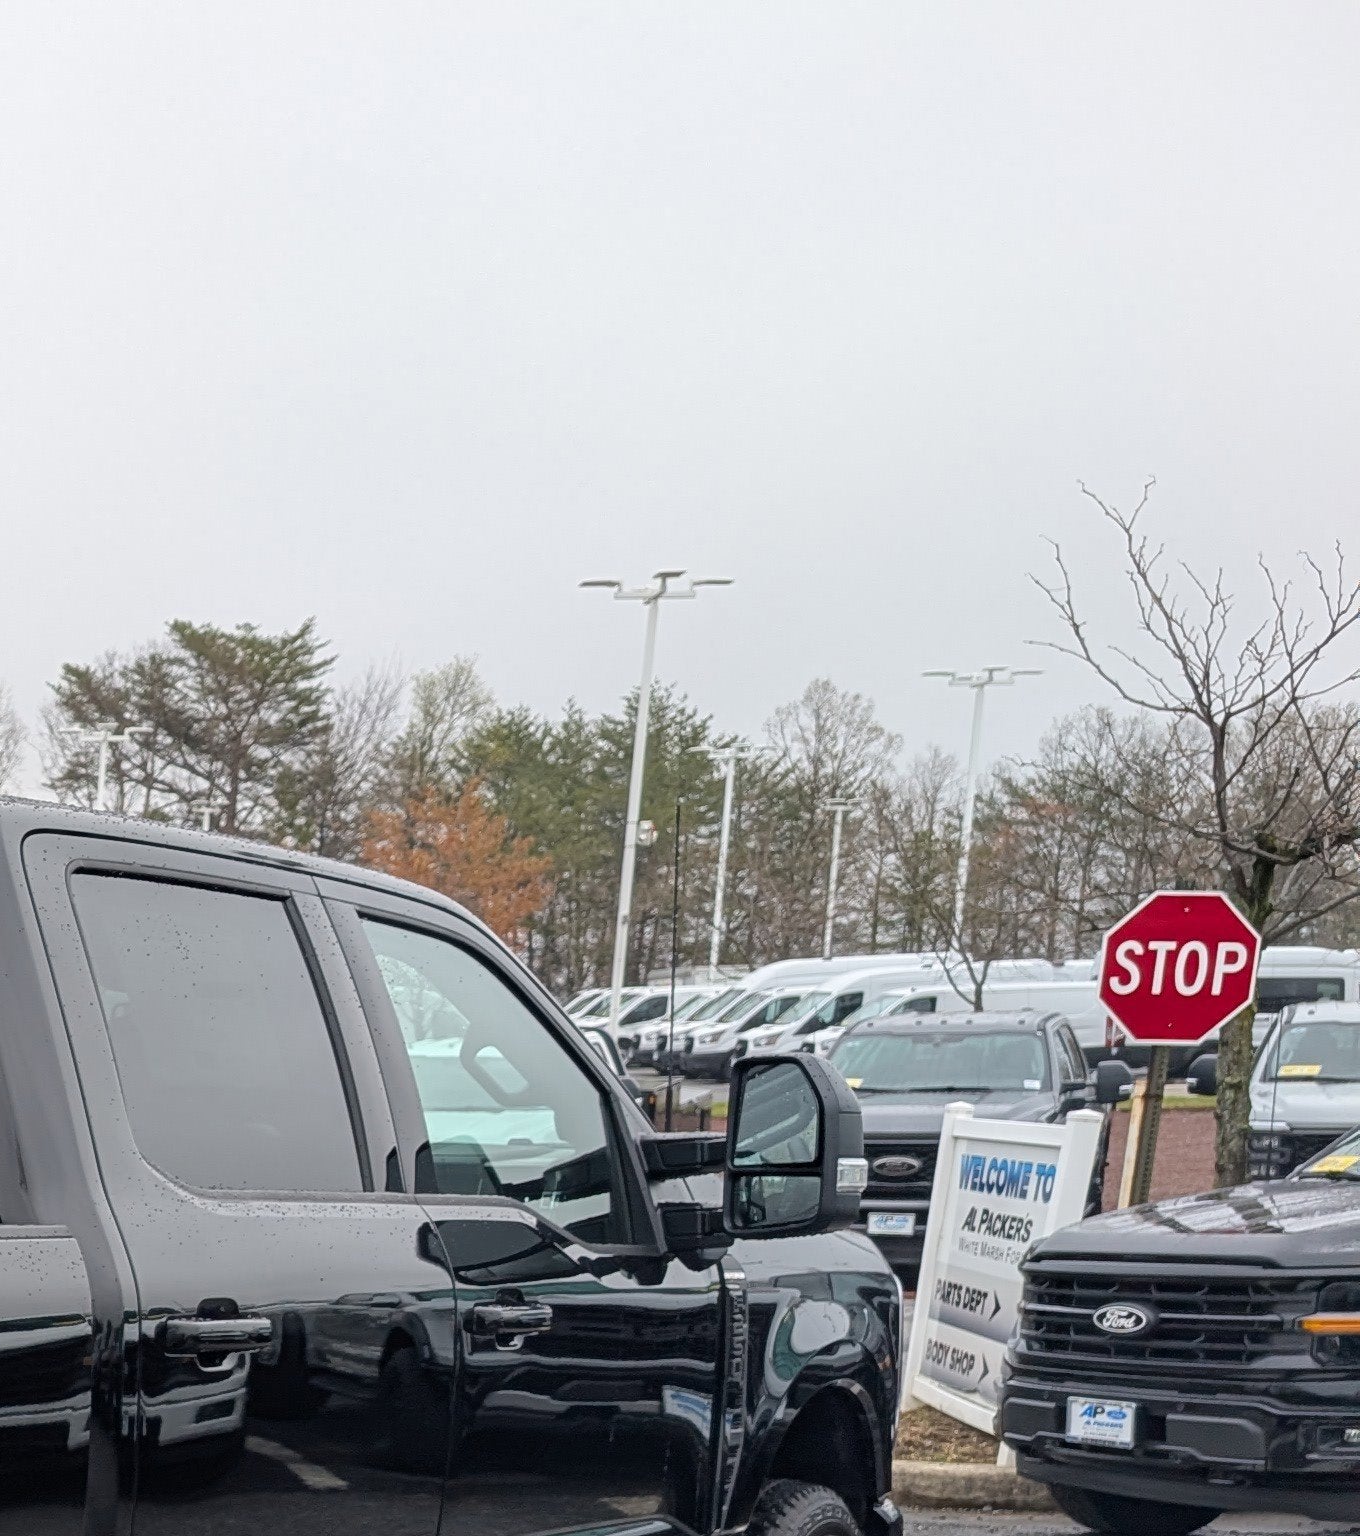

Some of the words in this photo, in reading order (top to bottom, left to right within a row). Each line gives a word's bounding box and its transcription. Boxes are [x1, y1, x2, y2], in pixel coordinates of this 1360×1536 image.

[1109, 939, 1248, 997] STOP
[959, 1153, 1032, 1200] WELCOME
[1034, 1163, 1057, 1204] TO
[962, 1206, 978, 1234] AL
[980, 1208, 1033, 1242] PACKER'S
[935, 1279, 961, 1308] PARTS
[963, 1286, 988, 1314] DEPT
[1103, 1309, 1137, 1328] Ford
[926, 1339, 950, 1365] BODY
[950, 1345, 975, 1375] SHOP
[1080, 1404, 1105, 1418] AP
